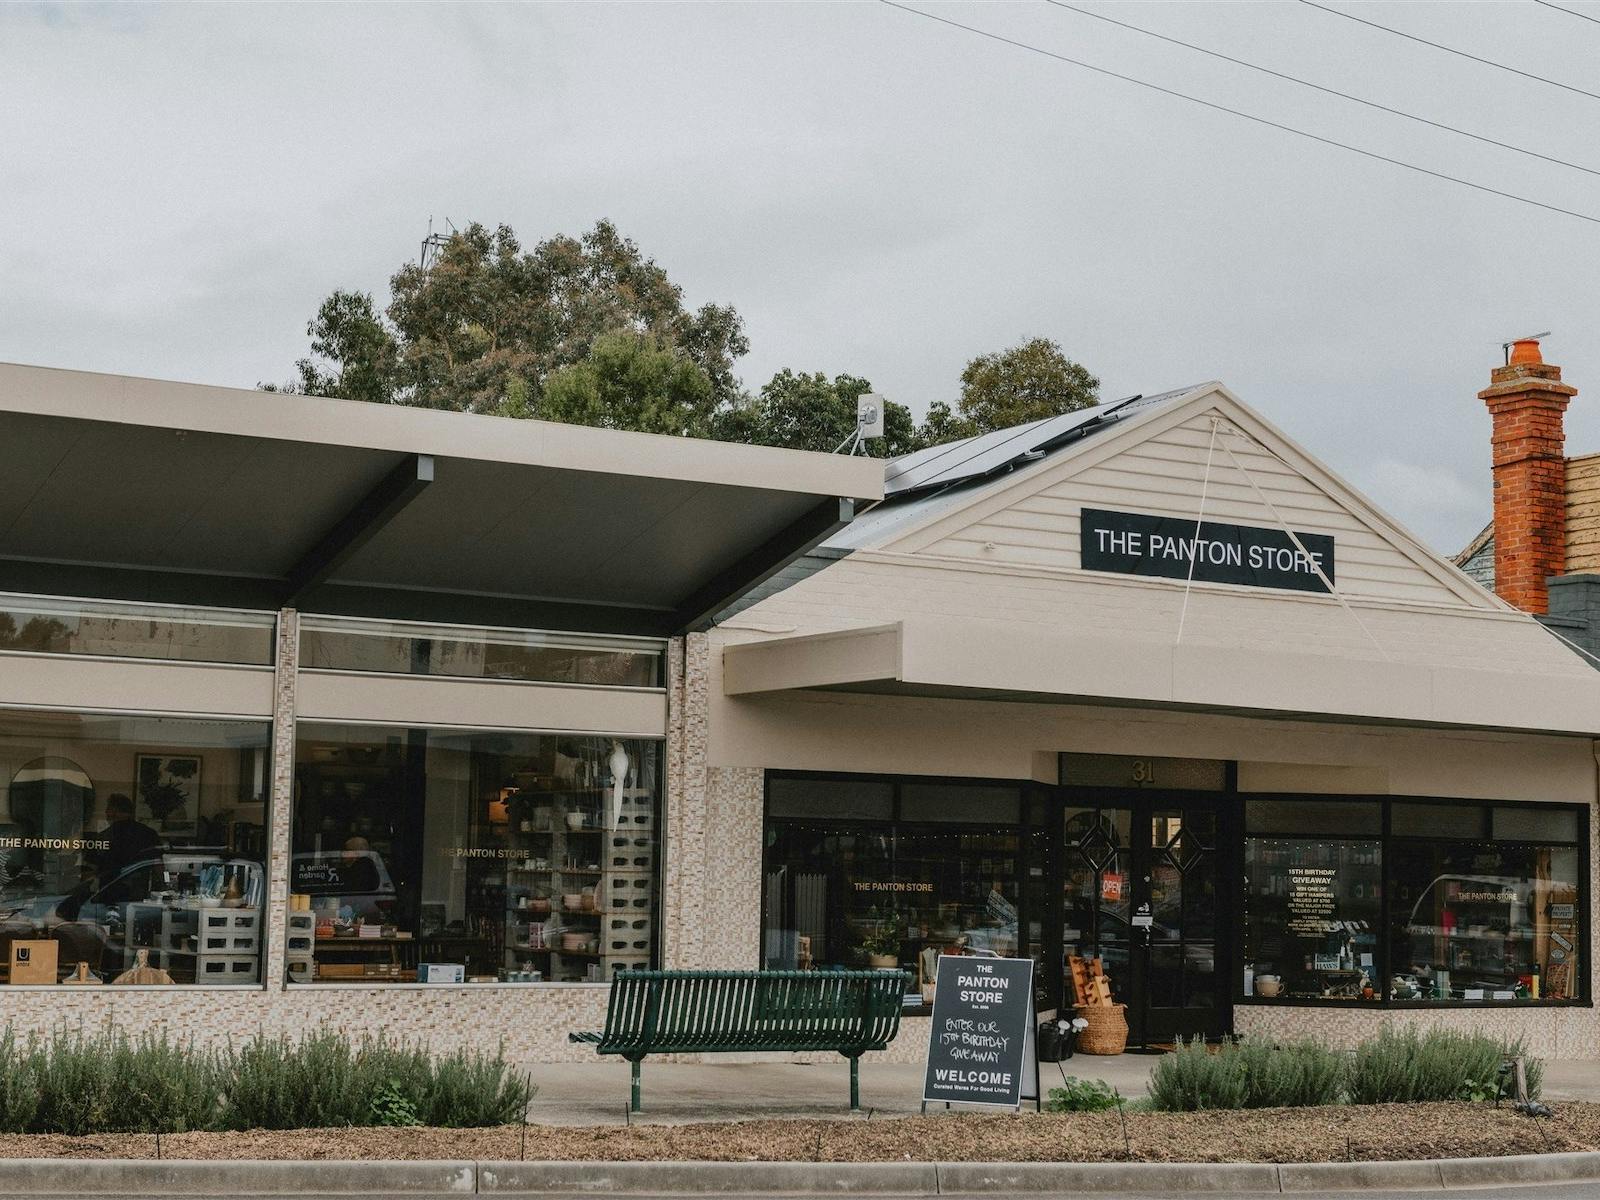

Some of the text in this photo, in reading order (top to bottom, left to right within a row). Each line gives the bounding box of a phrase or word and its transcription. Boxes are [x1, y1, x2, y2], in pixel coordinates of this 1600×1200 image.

[1094, 528, 1323, 575] THE PANTON STORE
[1132, 760, 1154, 783] 31
[0, 838, 110, 851] THE PANTON STORE
[457, 848, 496, 859] PANTON
[497, 849, 530, 859] STORE
[854, 882, 933, 892] THE PANTON STORE
[1102, 878, 1121, 895] OPEN
[1458, 892, 1518, 901] THE PANTON STORE
[976, 965, 993, 974] THE
[957, 975, 1009, 989] PANTON
[960, 990, 1003, 1004] STORE
[945, 1018, 1000, 1033] ENTER OUR
[961, 1033, 1010, 1052] BIRTHDAY
[935, 1068, 1012, 1085] WELCOME
[994, 1086, 1010, 1095] Living
